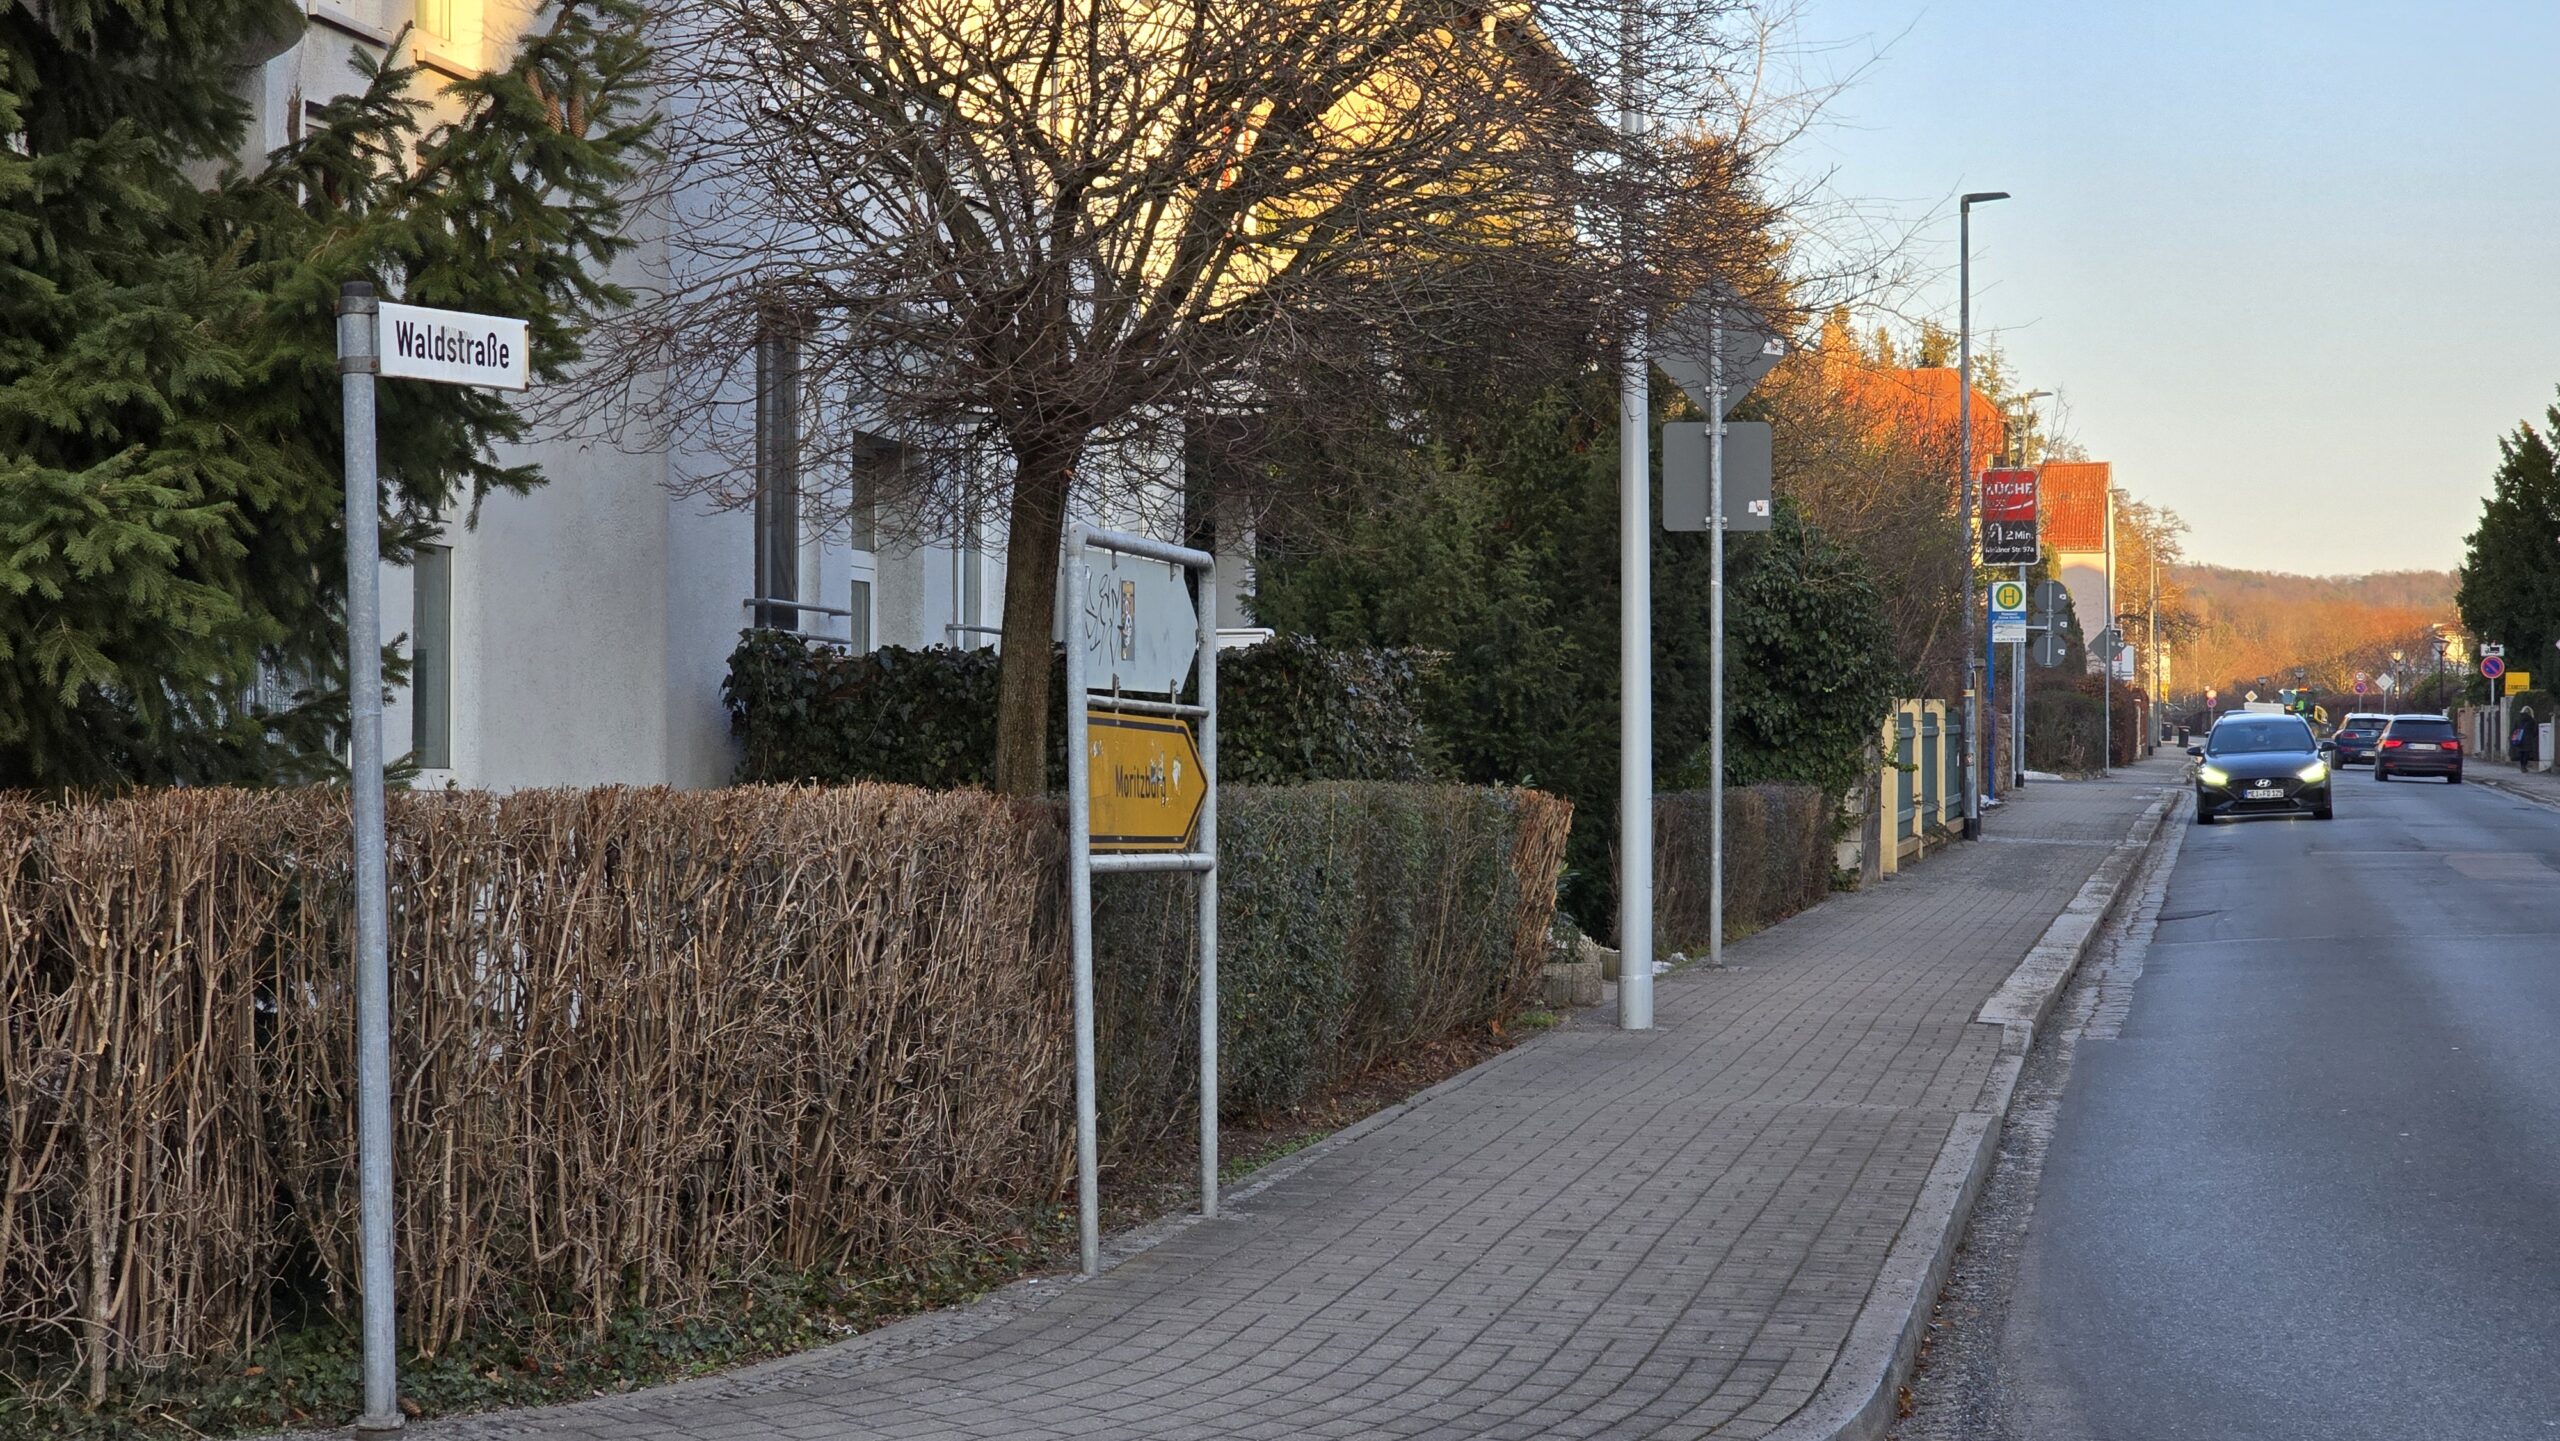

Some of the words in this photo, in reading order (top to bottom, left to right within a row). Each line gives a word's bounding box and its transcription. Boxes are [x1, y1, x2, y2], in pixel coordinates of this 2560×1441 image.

[396, 320, 509, 369] Waldstraße
[1986, 481, 2033, 495] KÜCHE
[2006, 530, 2014, 540] 2
[2014, 530, 2034, 540] Min.
[2003, 589, 2015, 604] H
